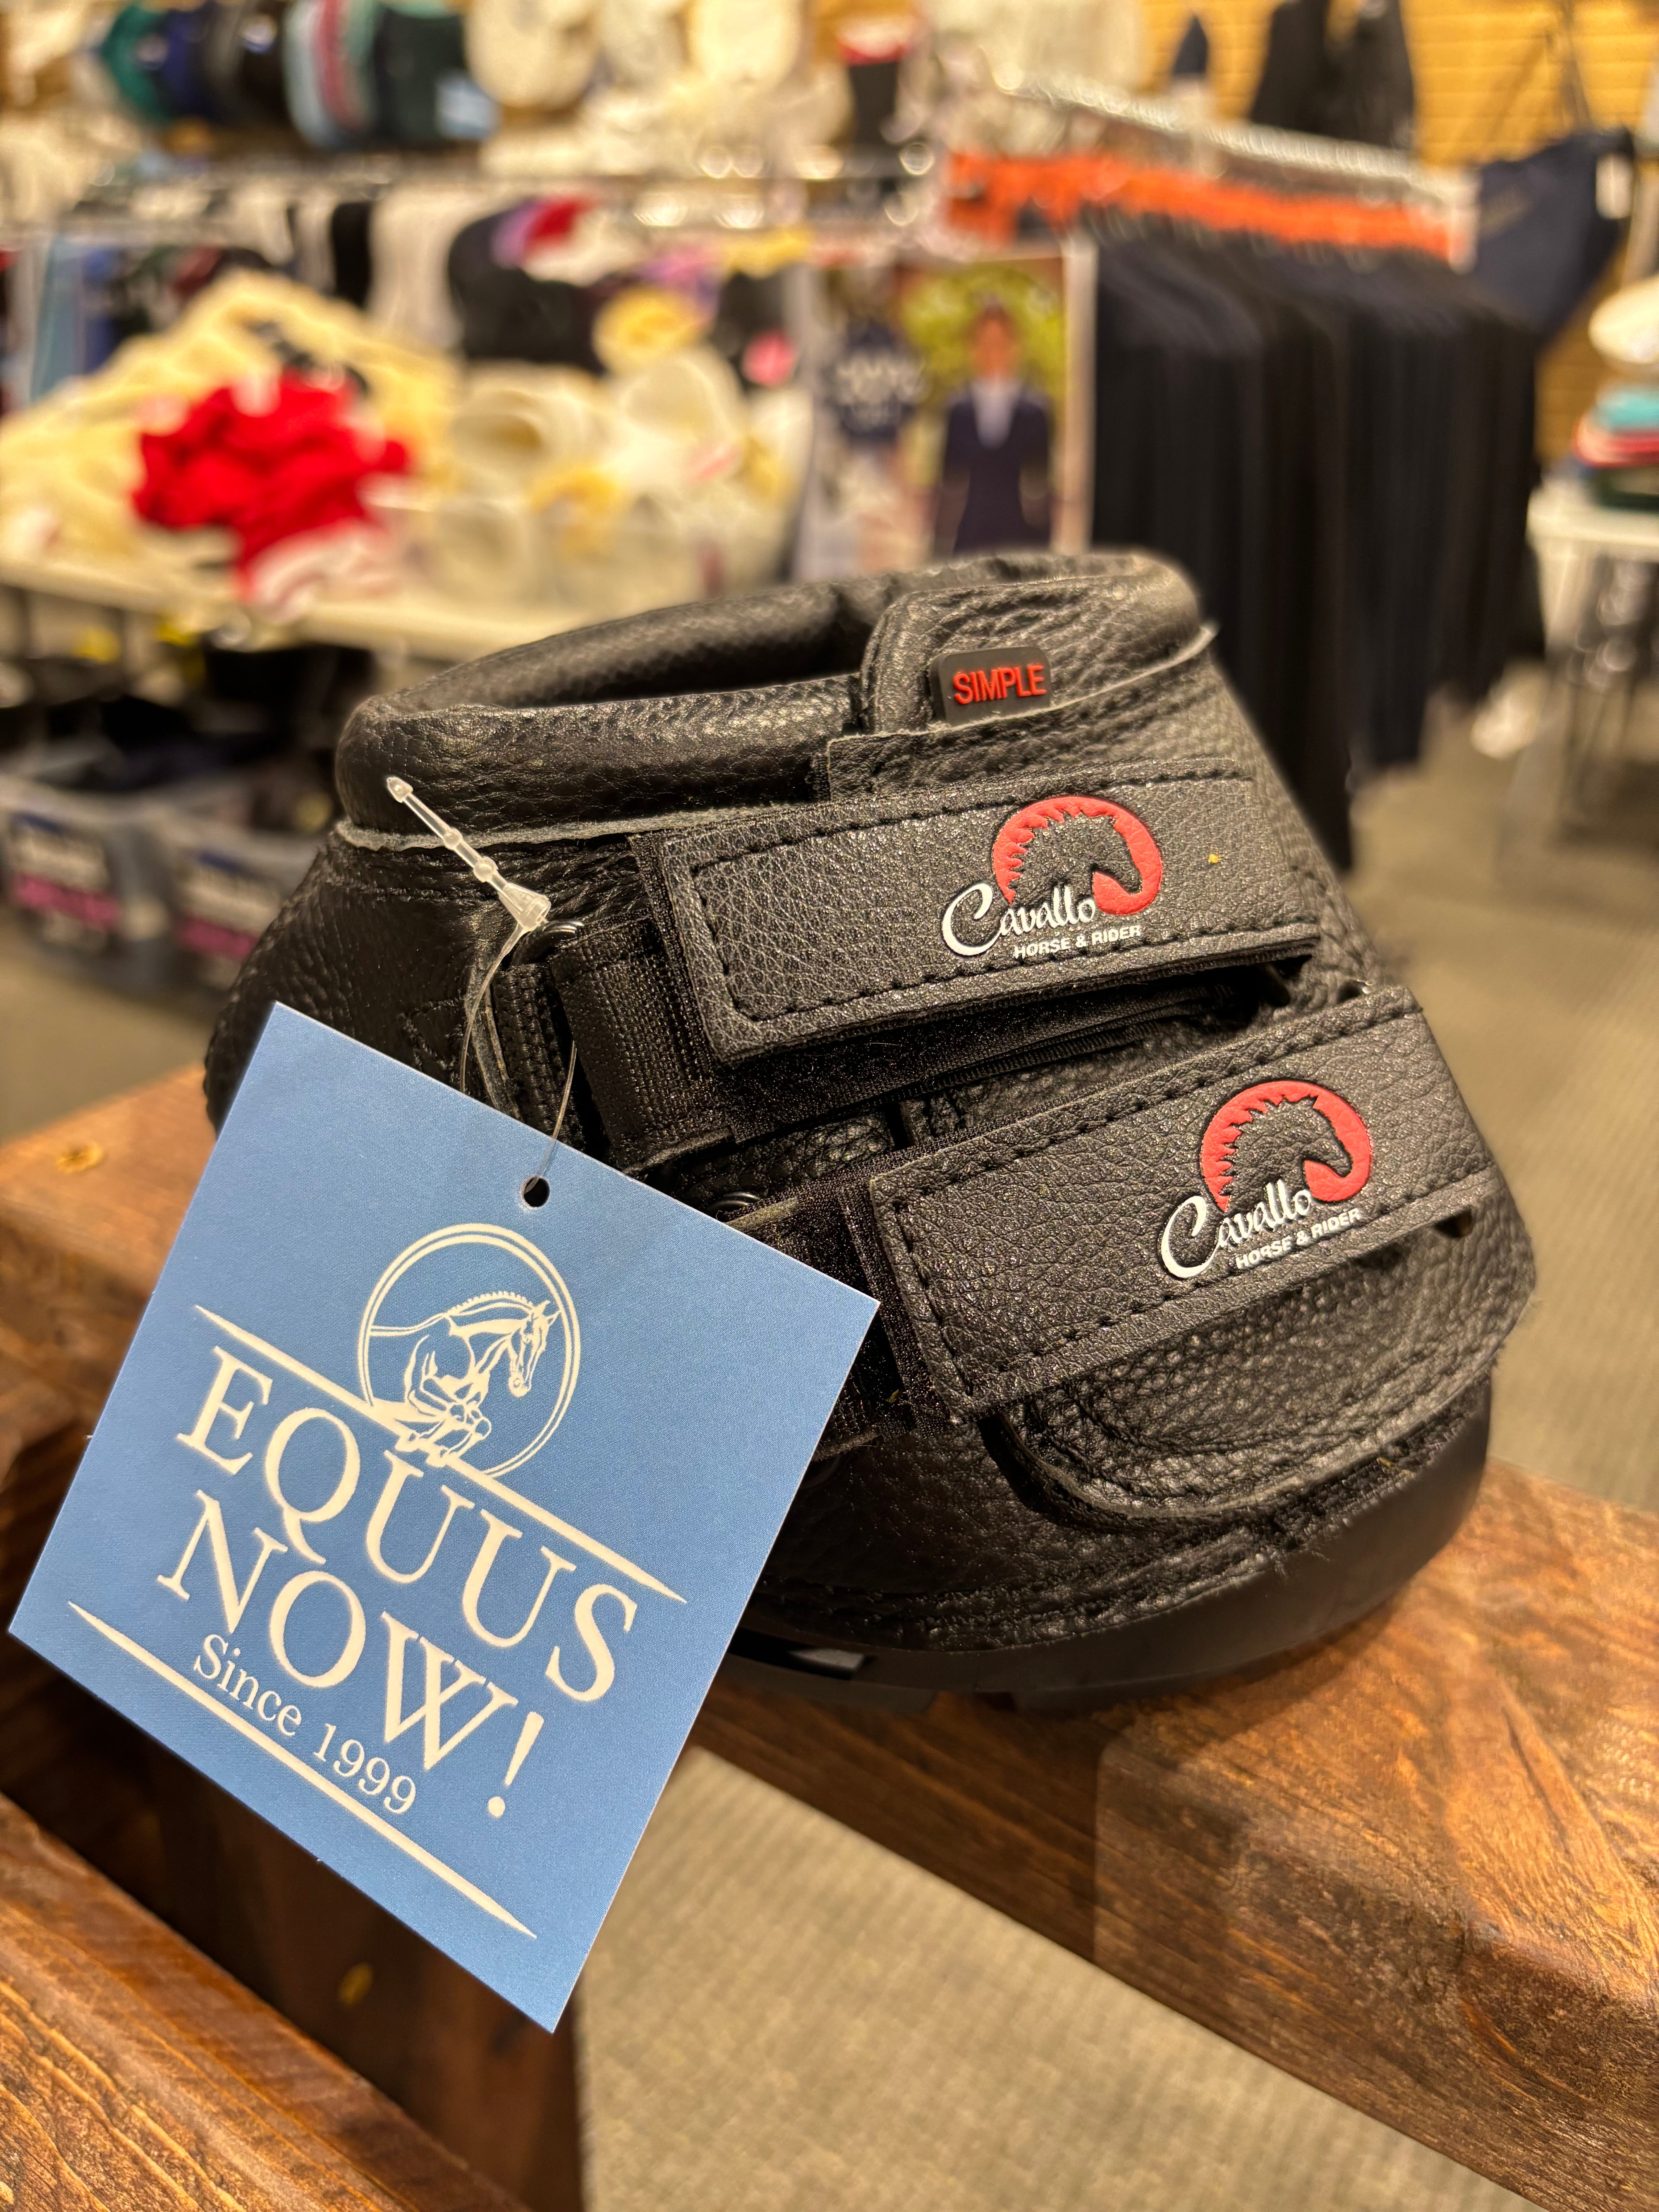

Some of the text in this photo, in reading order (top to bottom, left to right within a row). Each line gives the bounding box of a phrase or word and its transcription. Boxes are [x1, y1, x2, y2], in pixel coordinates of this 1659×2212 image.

[953, 665, 1047, 704] SIMPLE
[942, 883, 1096, 956] Cavallo
[1014, 924, 1142, 959] HORSE & RIDER
[1161, 1179, 1312, 1278] Cavallo
[1235, 1208, 1361, 1269] HORSE & RIDER
[177, 1346, 638, 1702] EQUUS
[157, 1490, 546, 1818] NOW!
[192, 1634, 417, 1815] Since 1999
